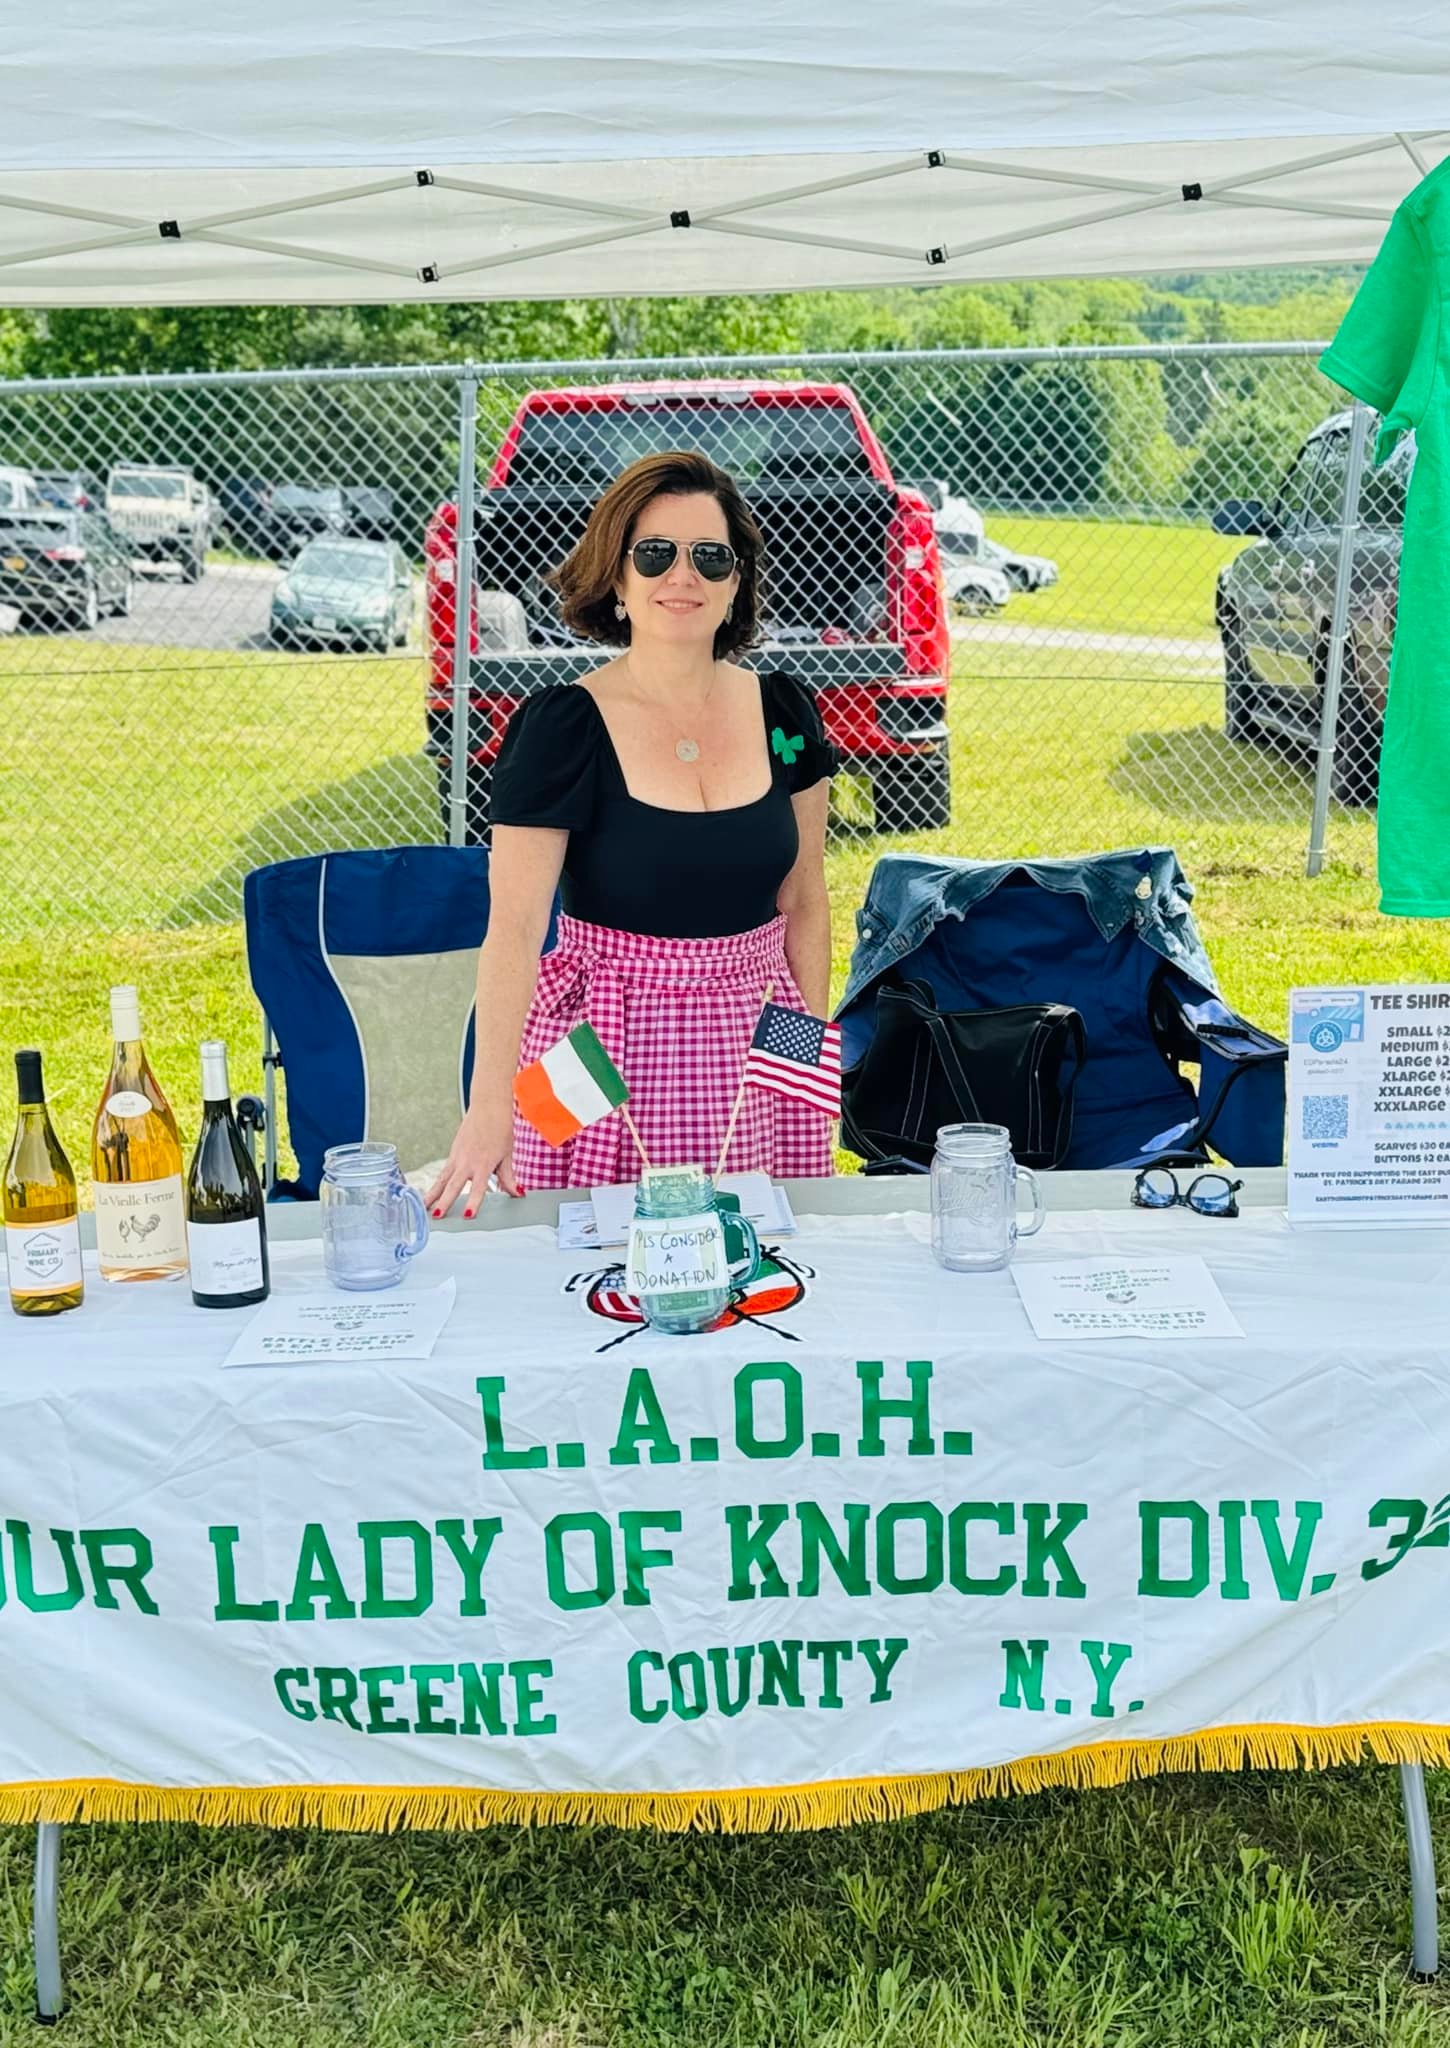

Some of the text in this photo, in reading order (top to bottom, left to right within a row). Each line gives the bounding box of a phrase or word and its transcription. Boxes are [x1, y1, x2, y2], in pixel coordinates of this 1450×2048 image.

[1370, 995, 1403, 1010] TEE
[633, 1261, 717, 1290] DONATION
[664, 1253, 673, 1264] A
[475, 1360, 974, 1471] L.A.O.H.
[0, 1518, 160, 1617] UR
[208, 1515, 503, 1623] LADY
[543, 1510, 683, 1611] OF
[724, 1499, 1089, 1602] KNOCK
[1137, 1498, 1338, 1603] DIV.
[273, 1637, 1145, 1737] GREENE COUNTY N.Y.
